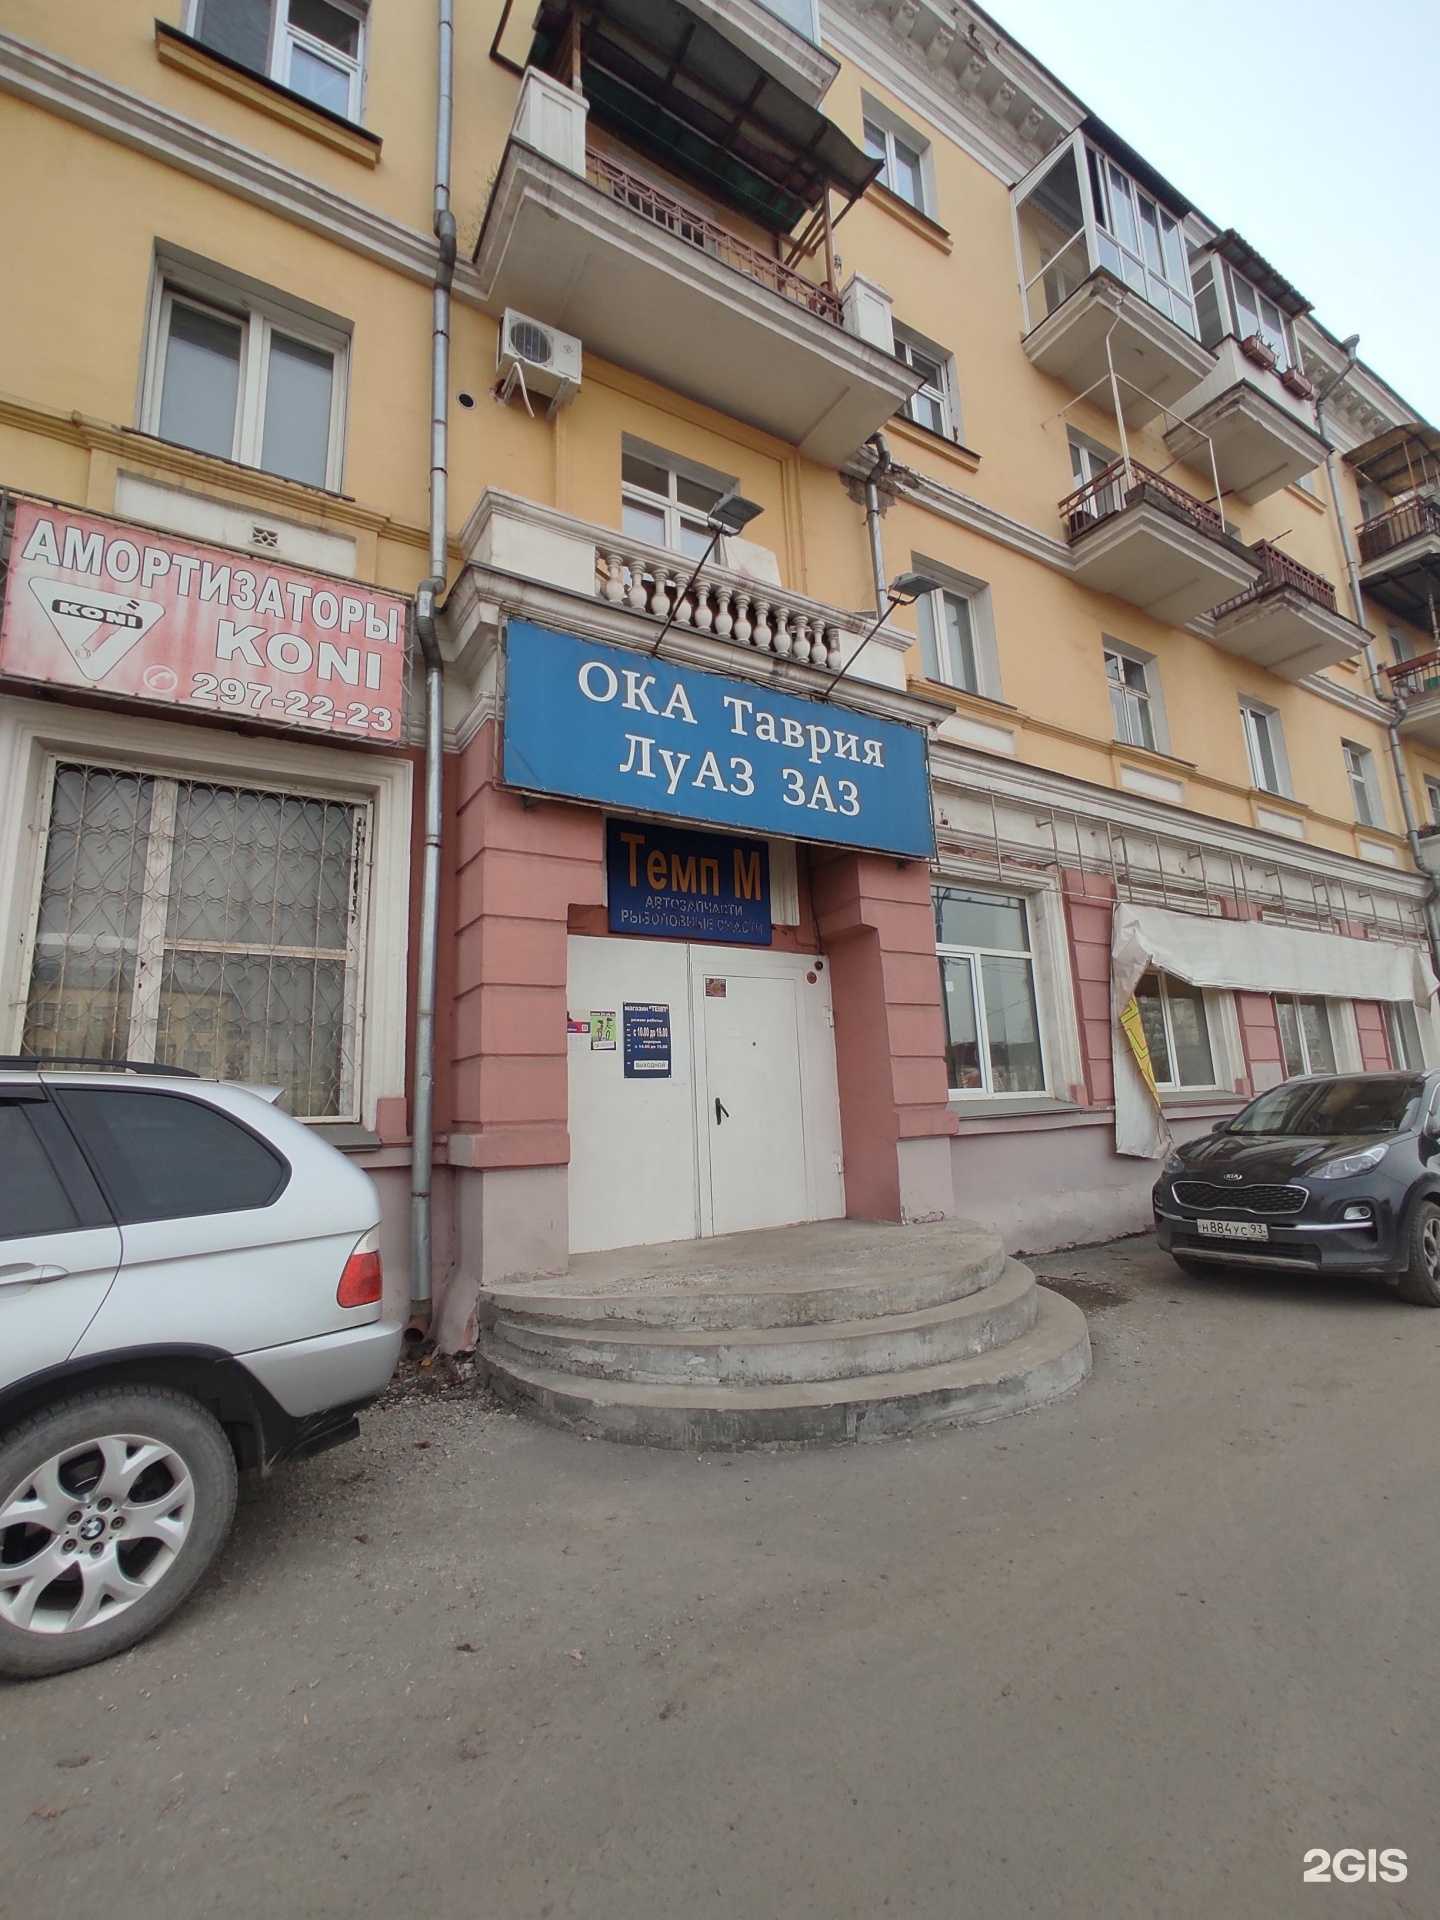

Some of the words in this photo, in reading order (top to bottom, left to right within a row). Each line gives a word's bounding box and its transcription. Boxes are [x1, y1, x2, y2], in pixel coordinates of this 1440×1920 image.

[22, 519, 399, 644] АМОРТИЗАТОРЫ
[55, 600, 139, 628] KONI
[216, 619, 382, 690] KONI
[190, 672, 393, 732] 297-22-23
[578, 661, 698, 725] ОКА
[723, 695, 886, 768] Таврия
[619, 733, 756, 796] ЛуАЗ
[782, 767, 862, 817] ЗАЗ
[619, 831, 721, 897] Темп
[733, 848, 762, 901] М
